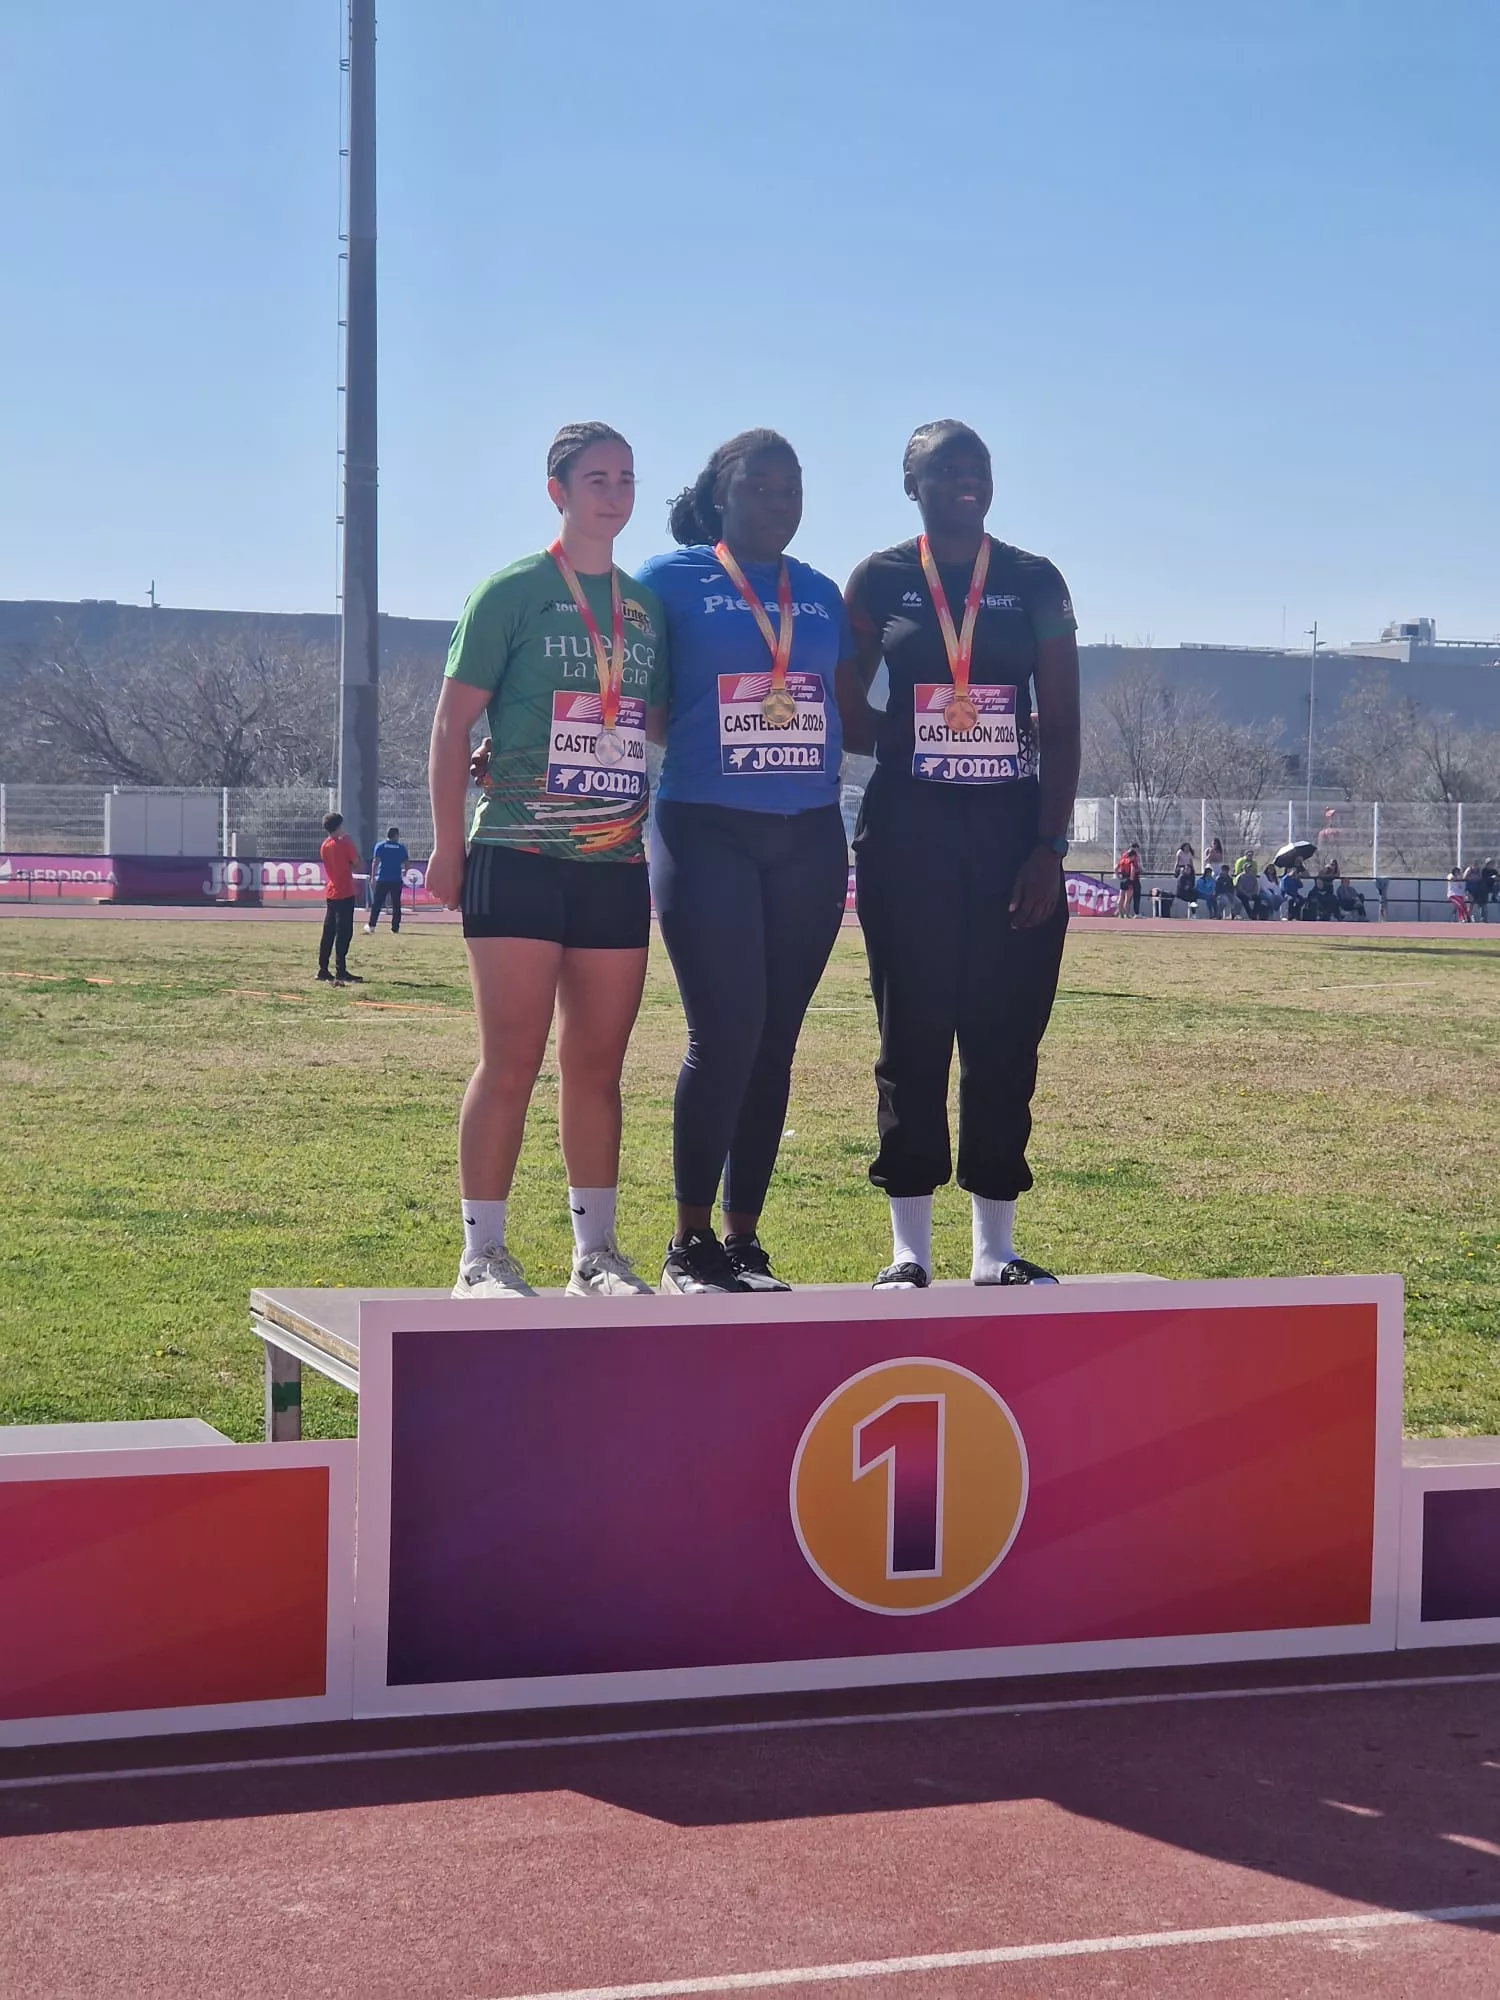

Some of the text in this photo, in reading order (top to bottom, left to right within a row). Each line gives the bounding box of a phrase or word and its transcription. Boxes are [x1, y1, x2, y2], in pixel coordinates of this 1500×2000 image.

[802, 713, 824, 731] 2026
[919, 721, 1015, 743] CASTELLÓN 2026
[554, 733, 644, 760] CASTE 2026
[851, 1392, 946, 1580] 1
